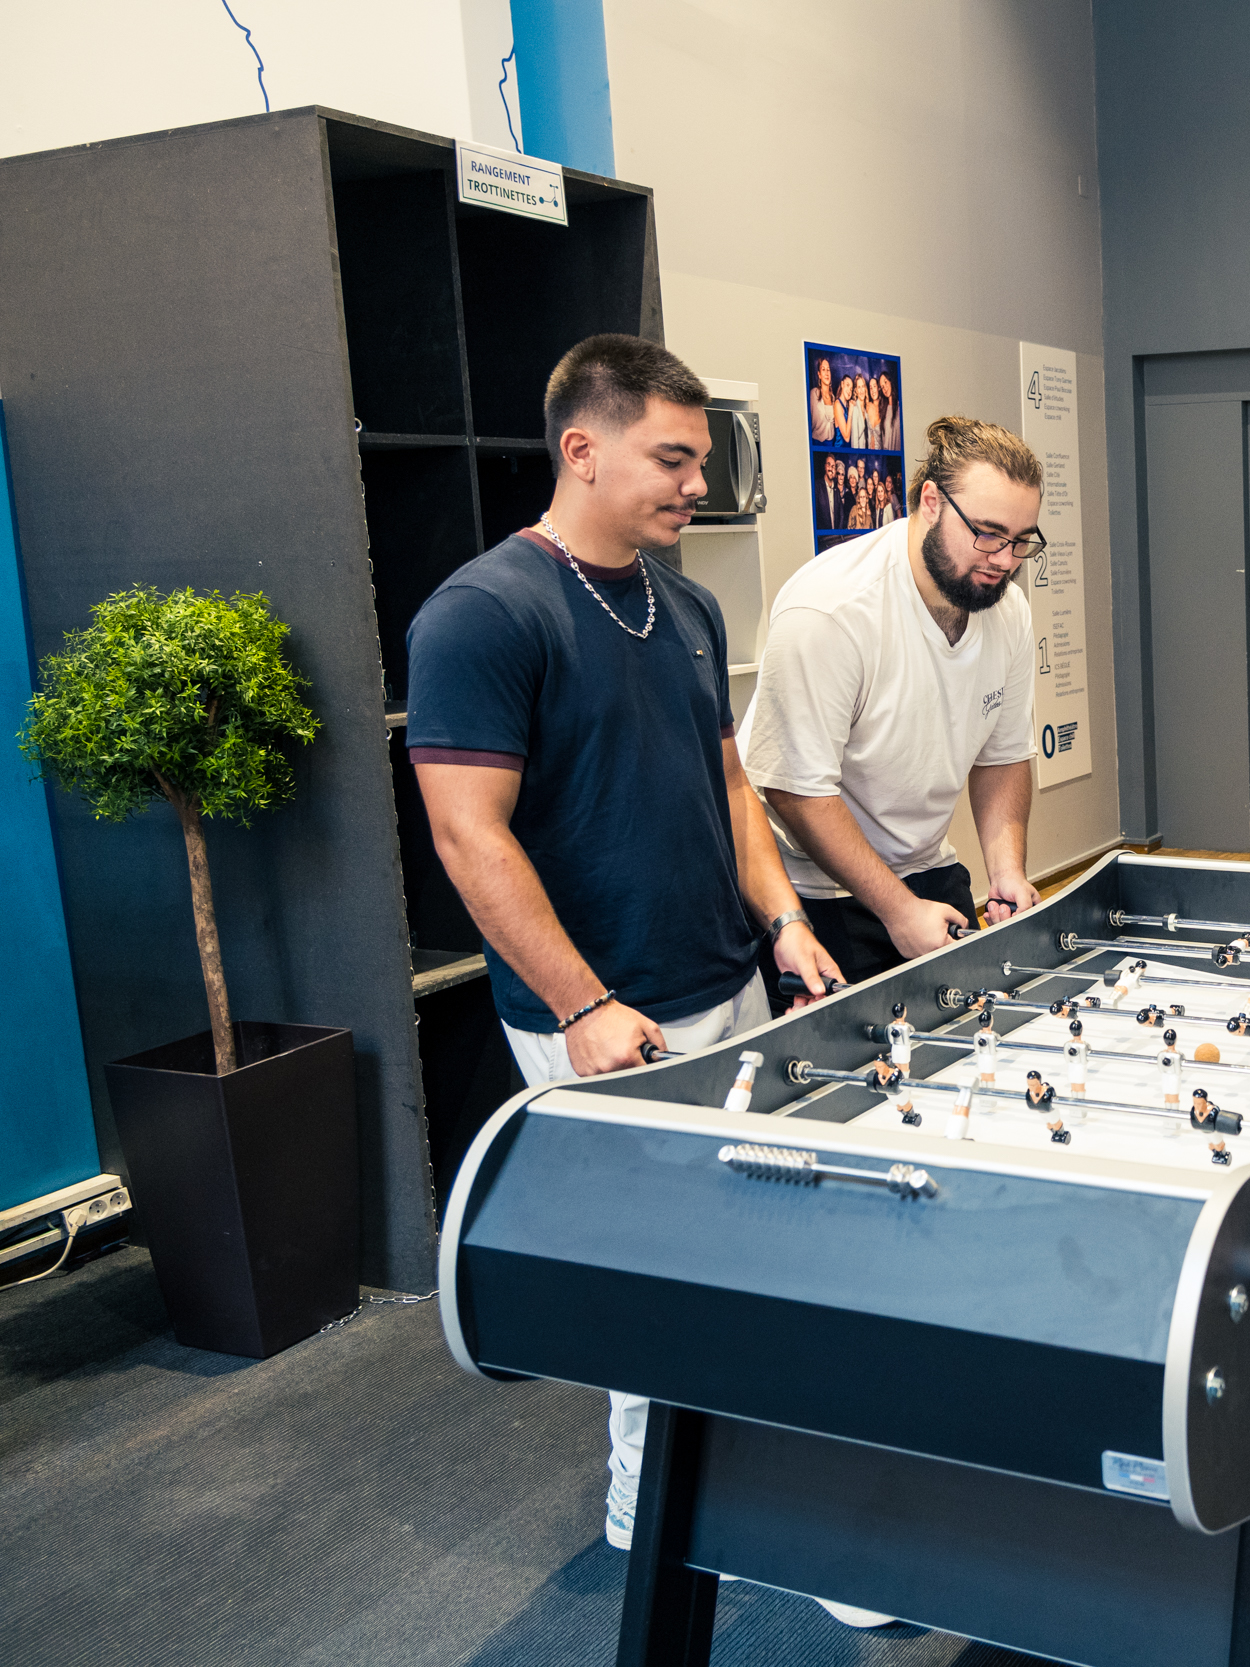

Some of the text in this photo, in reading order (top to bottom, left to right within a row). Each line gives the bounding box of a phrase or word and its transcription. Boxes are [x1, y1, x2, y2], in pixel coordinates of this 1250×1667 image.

[470, 160, 531, 186] RANGEMENT
[467, 178, 537, 206] TROTTINETTES
[1027, 371, 1042, 409] 4
[1034, 550, 1048, 587] 2
[1038, 637, 1050, 674] 1
[1042, 724, 1055, 759] 0
